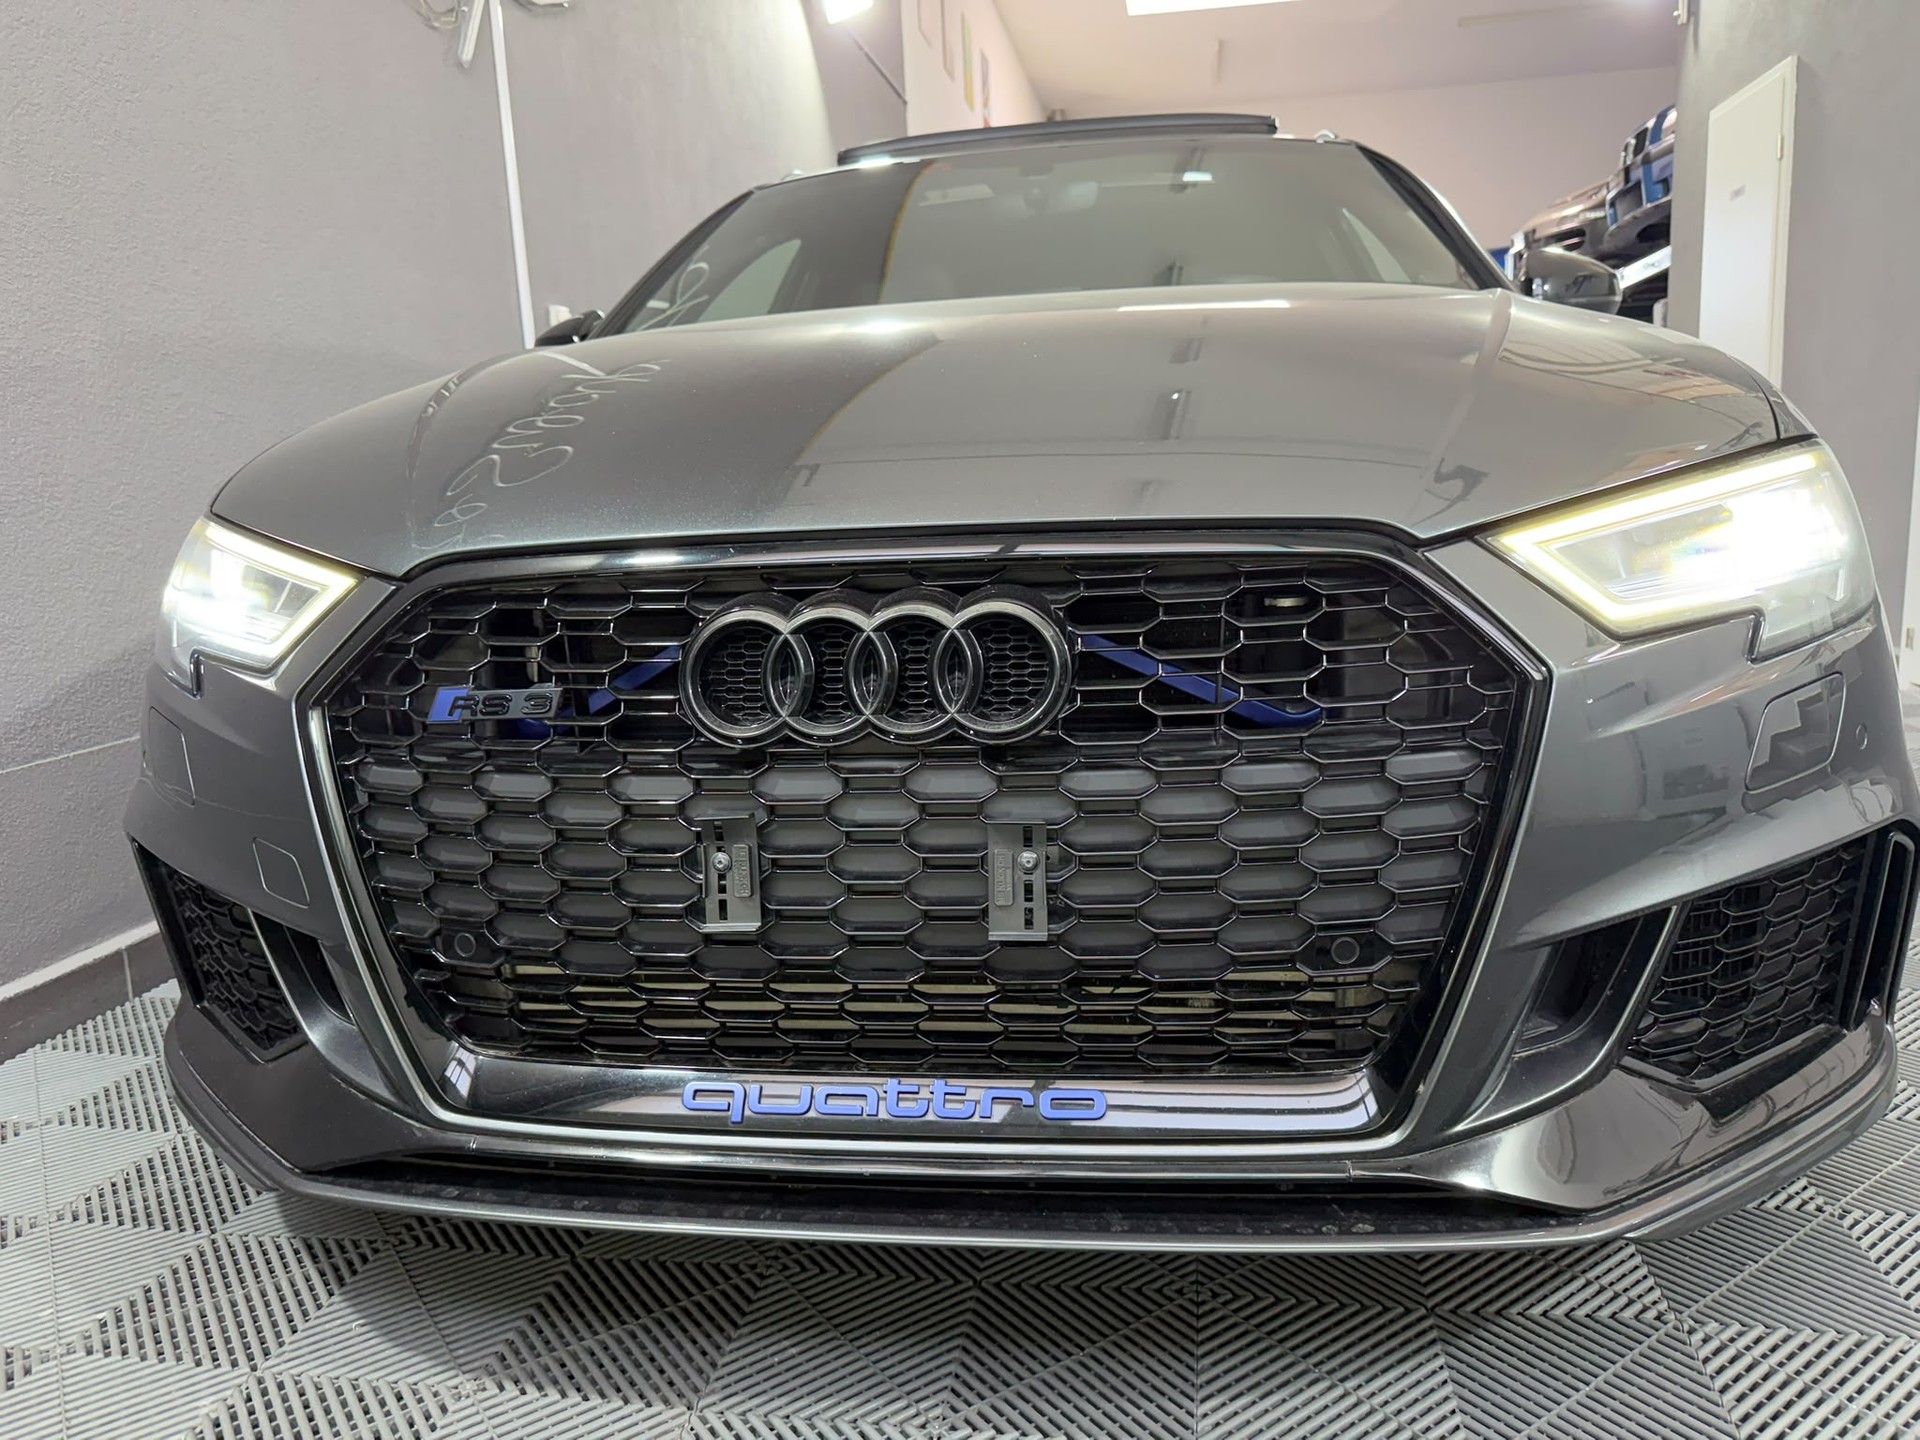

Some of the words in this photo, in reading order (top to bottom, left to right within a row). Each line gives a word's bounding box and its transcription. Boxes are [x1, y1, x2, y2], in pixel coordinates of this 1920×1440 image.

[447, 693, 512, 718] RS
[521, 691, 554, 715] 3
[681, 1078, 1107, 1124] quattro
